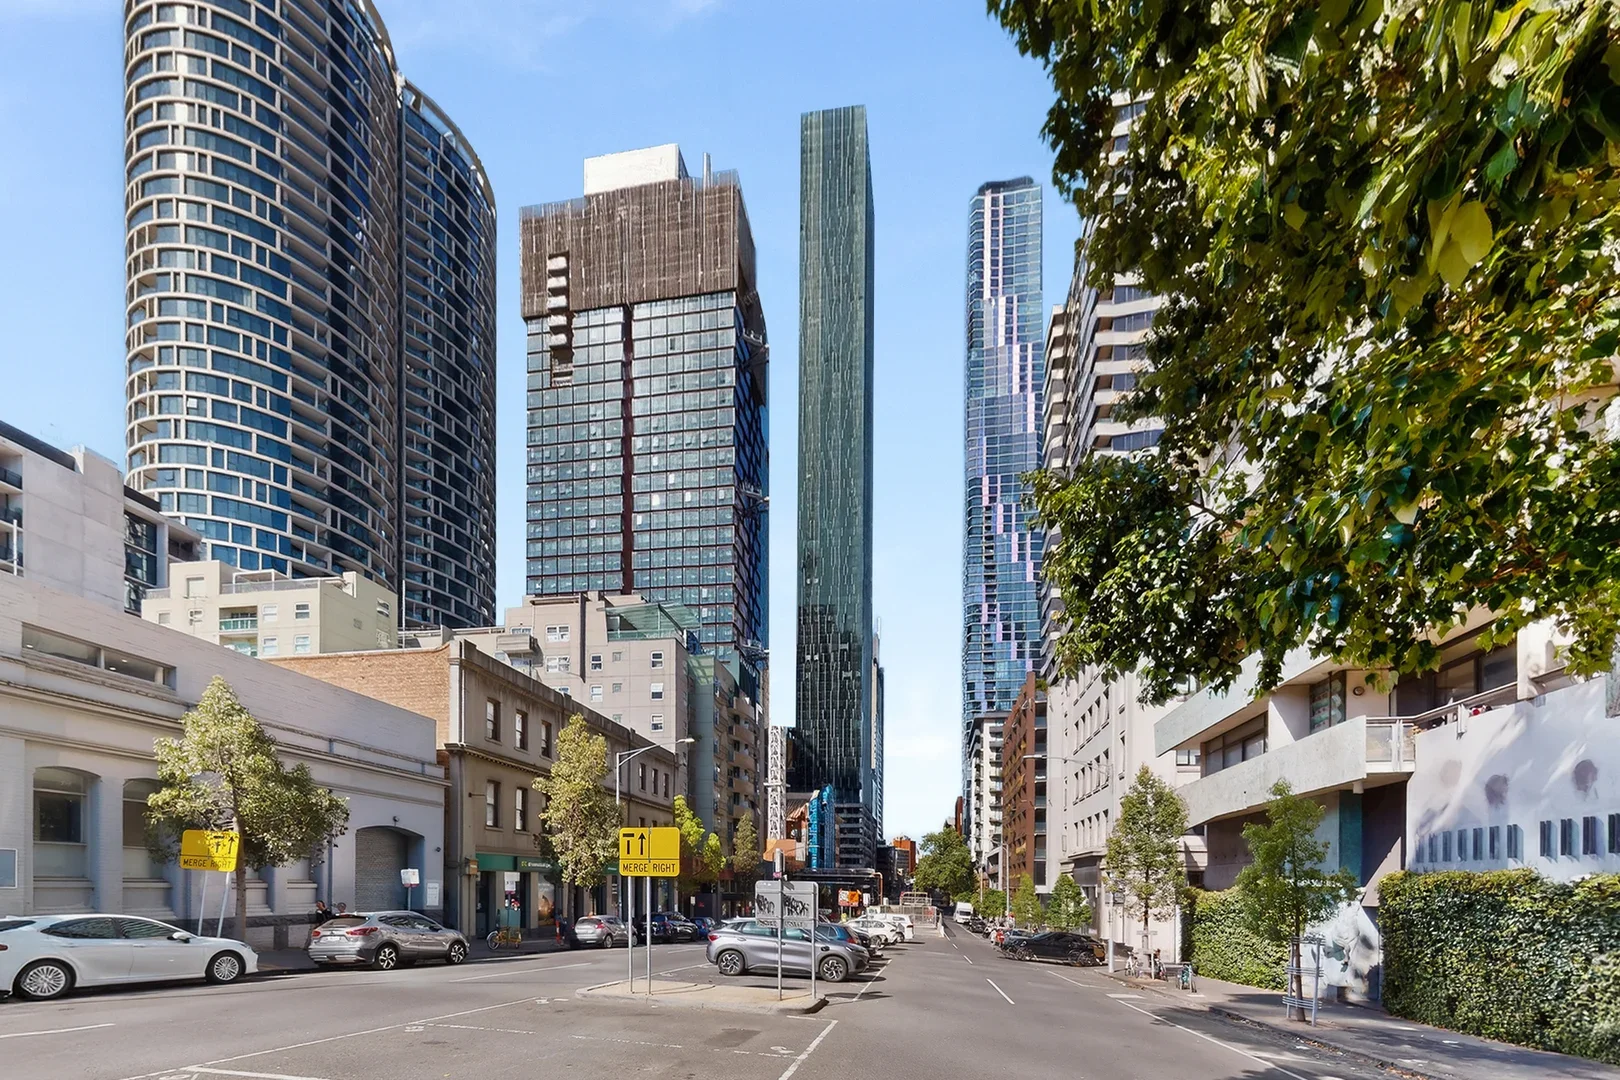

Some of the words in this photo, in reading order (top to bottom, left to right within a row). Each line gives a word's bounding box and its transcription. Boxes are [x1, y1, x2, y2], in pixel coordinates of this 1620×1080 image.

[182, 858, 207, 868] MERGE
[622, 863, 649, 873] MERGE
[652, 863, 676, 873] RIGHT
